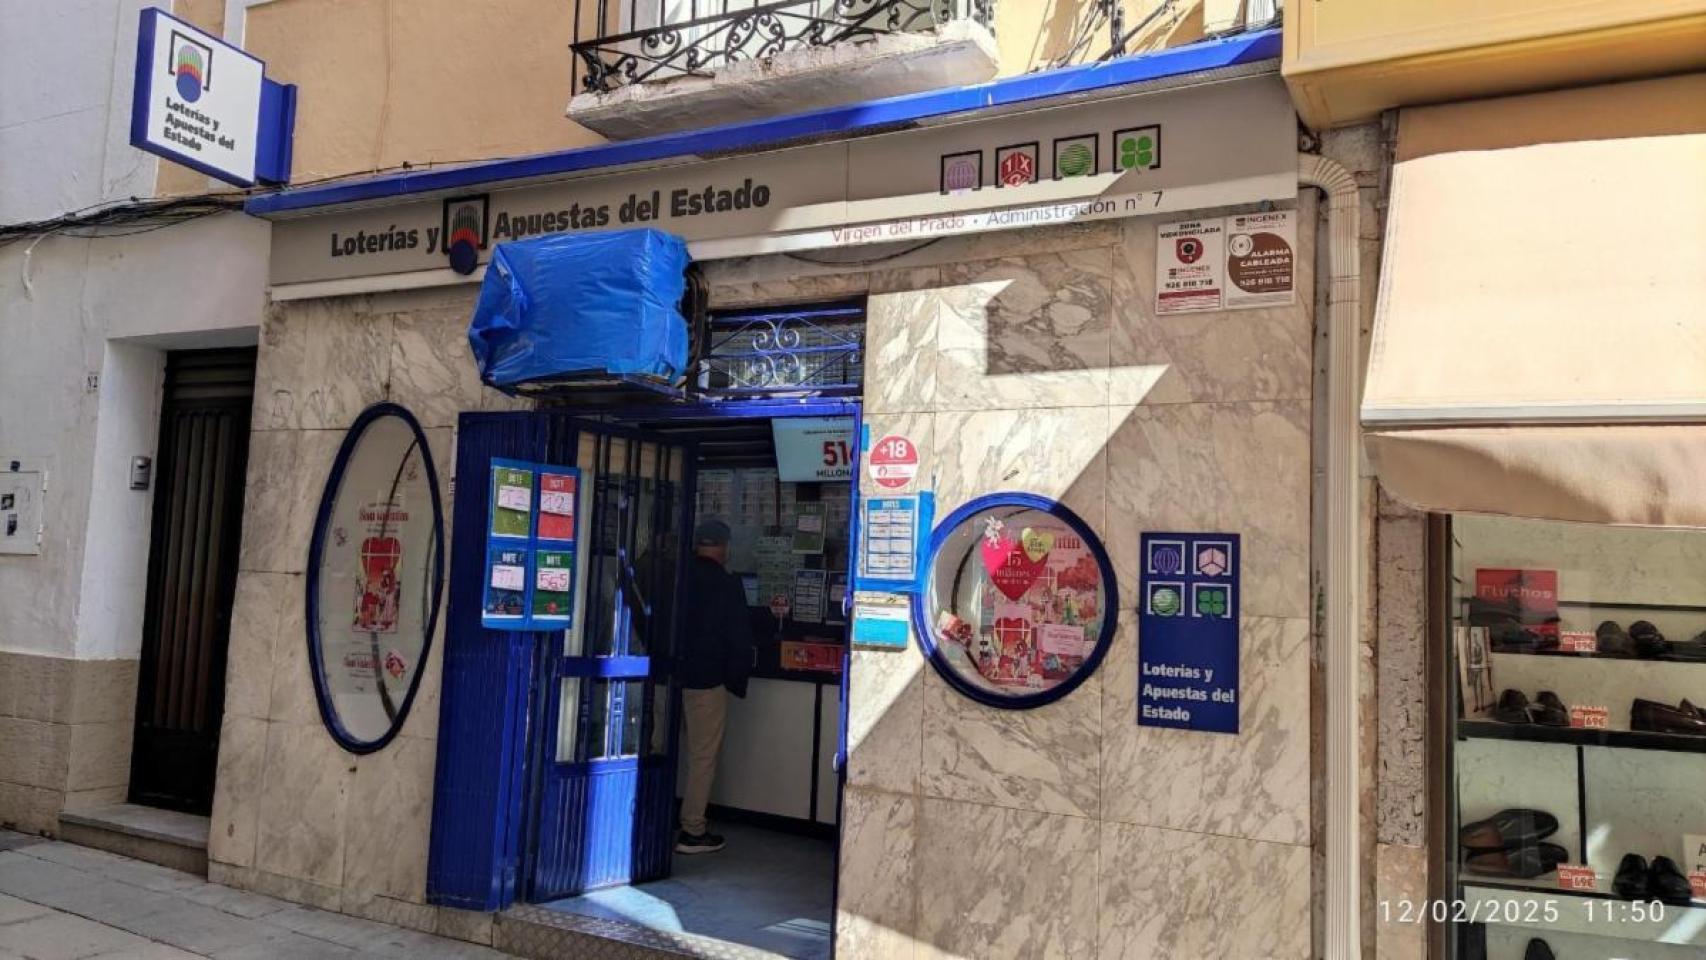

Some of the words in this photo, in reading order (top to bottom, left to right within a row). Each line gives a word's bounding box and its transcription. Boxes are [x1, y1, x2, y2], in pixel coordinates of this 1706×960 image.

[166, 96, 211, 124] Loterías
[213, 119, 220, 131] y
[165, 113, 215, 143] Apuestas
[219, 136, 235, 151] del
[165, 128, 202, 151] Estado
[331, 225, 418, 257] Loterías
[426, 227, 440, 254] y
[493, 202, 609, 239] Apuestas
[619, 191, 660, 223] del
[670, 178, 771, 217] Estado
[832, 225, 882, 244] Virgen
[889, 219, 912, 234] del
[919, 214, 965, 233] Prado
[987, 197, 1115, 226] Administración
[1152, 190, 1164, 208] 7
[1240, 258, 1290, 267] CABLEADA
[1252, 249, 1290, 257] ALARMA
[823, 441, 853, 466] 51
[880, 439, 907, 459] +18
[816, 469, 853, 478] MILLON
[1482, 585, 1552, 600] Fluchos
[1204, 667, 1214, 683] y
[1143, 683, 1207, 701] Apuestas
[1212, 688, 1235, 703] del
[1143, 704, 1190, 721] Estado
